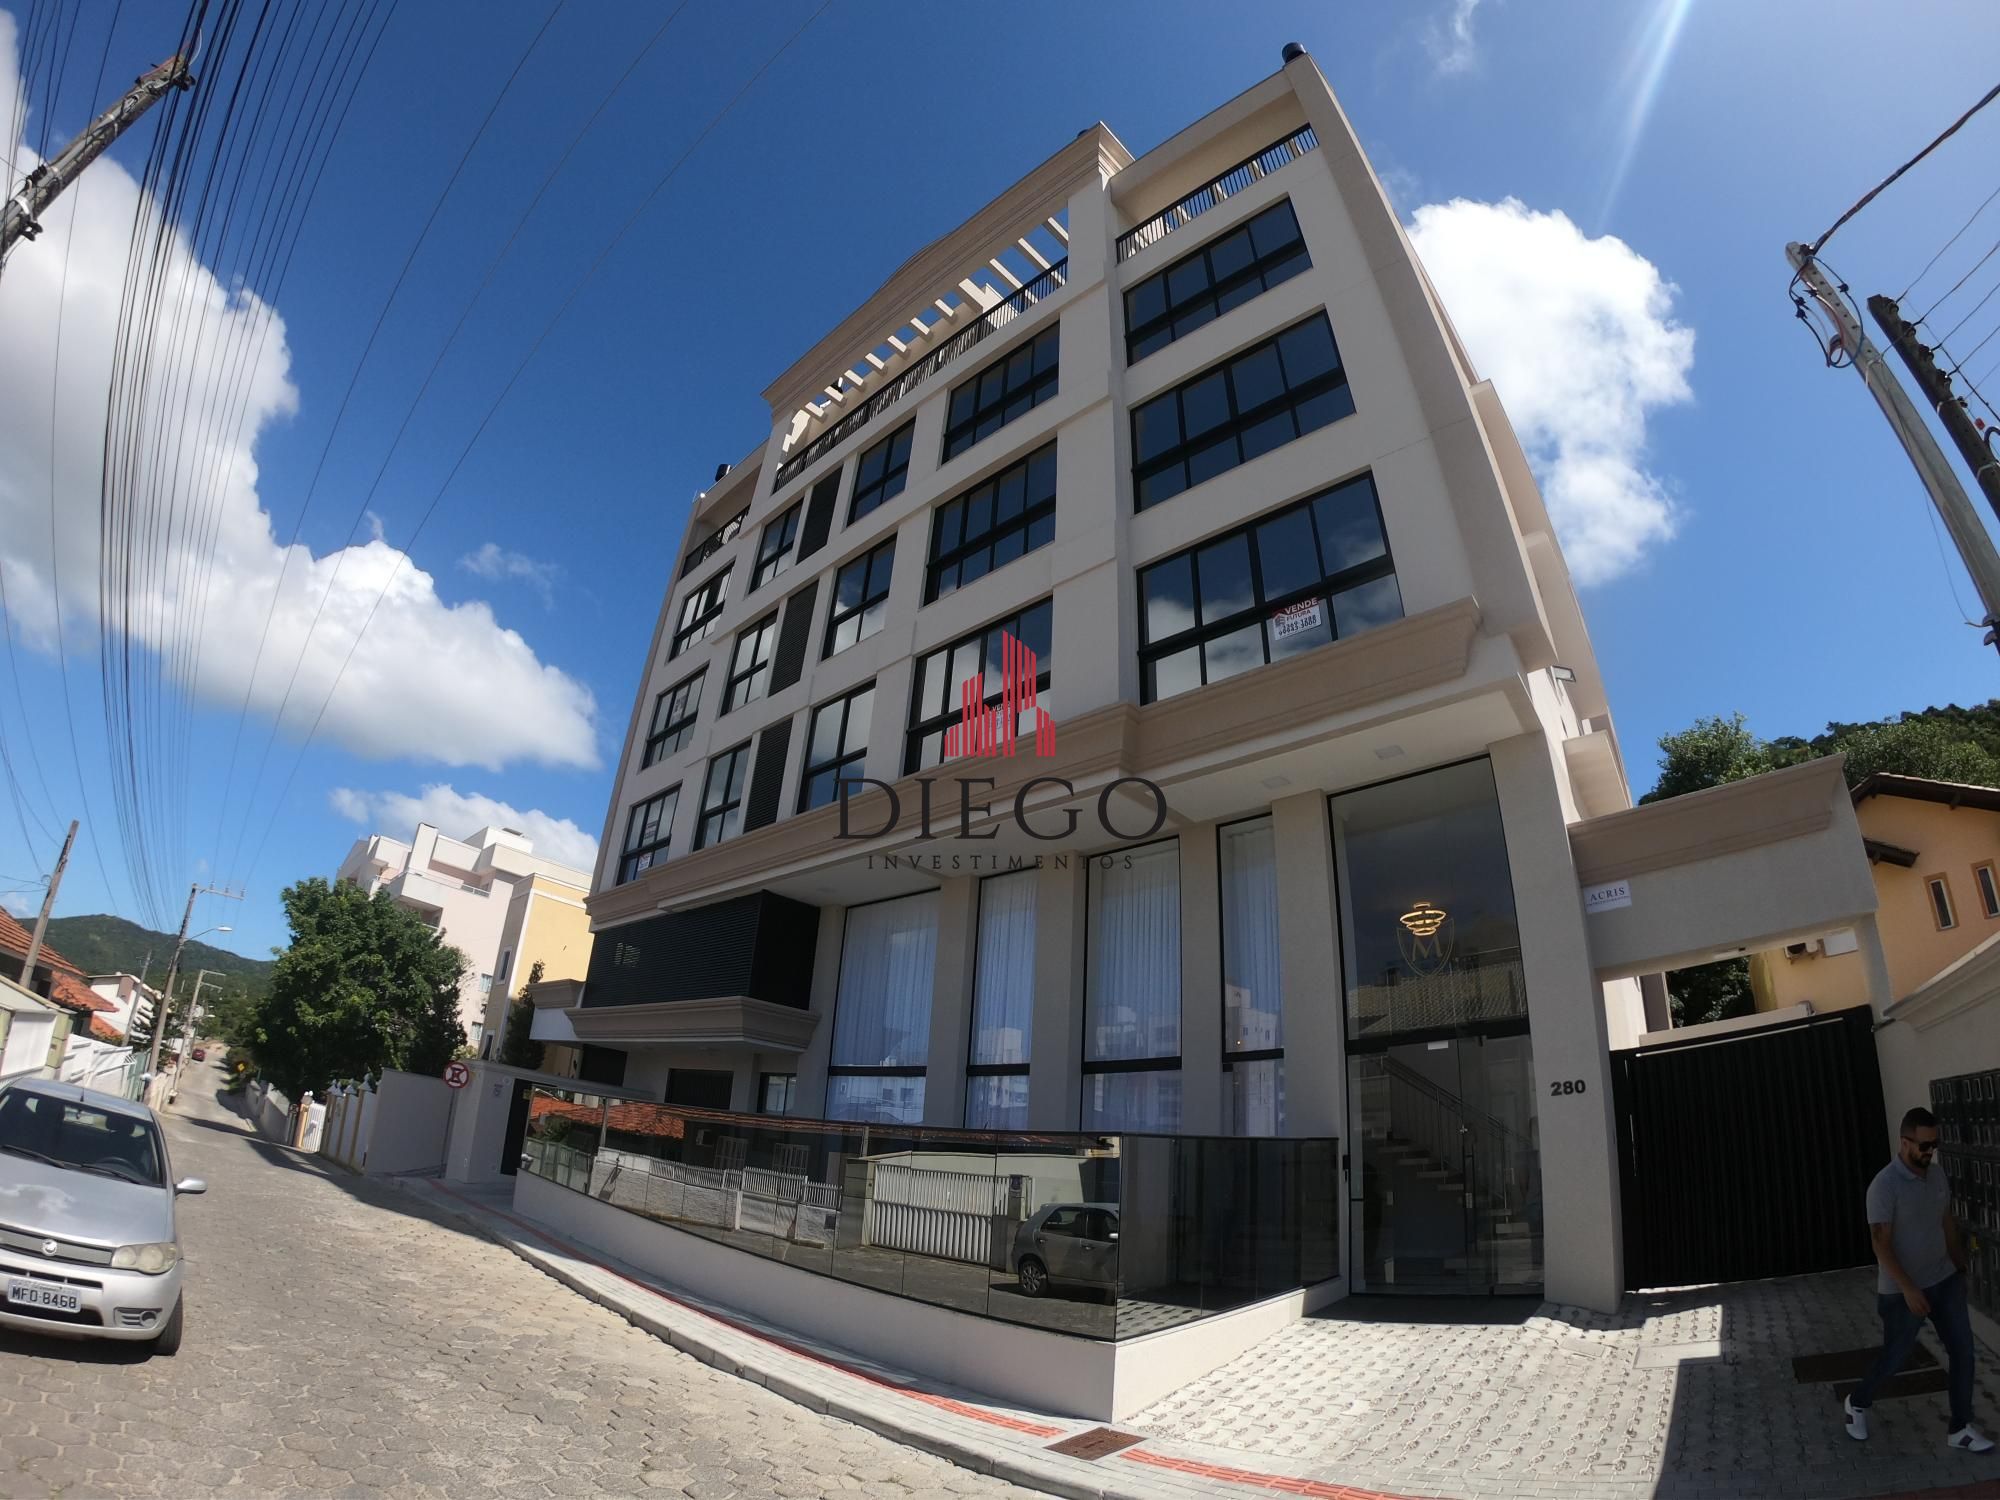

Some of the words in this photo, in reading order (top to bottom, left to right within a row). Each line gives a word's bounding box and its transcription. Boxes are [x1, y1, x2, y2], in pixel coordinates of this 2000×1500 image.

[1285, 597, 1318, 614] VENDE
[1590, 887, 1625, 901] ACRIS
[1550, 1079, 1586, 1096] 280
